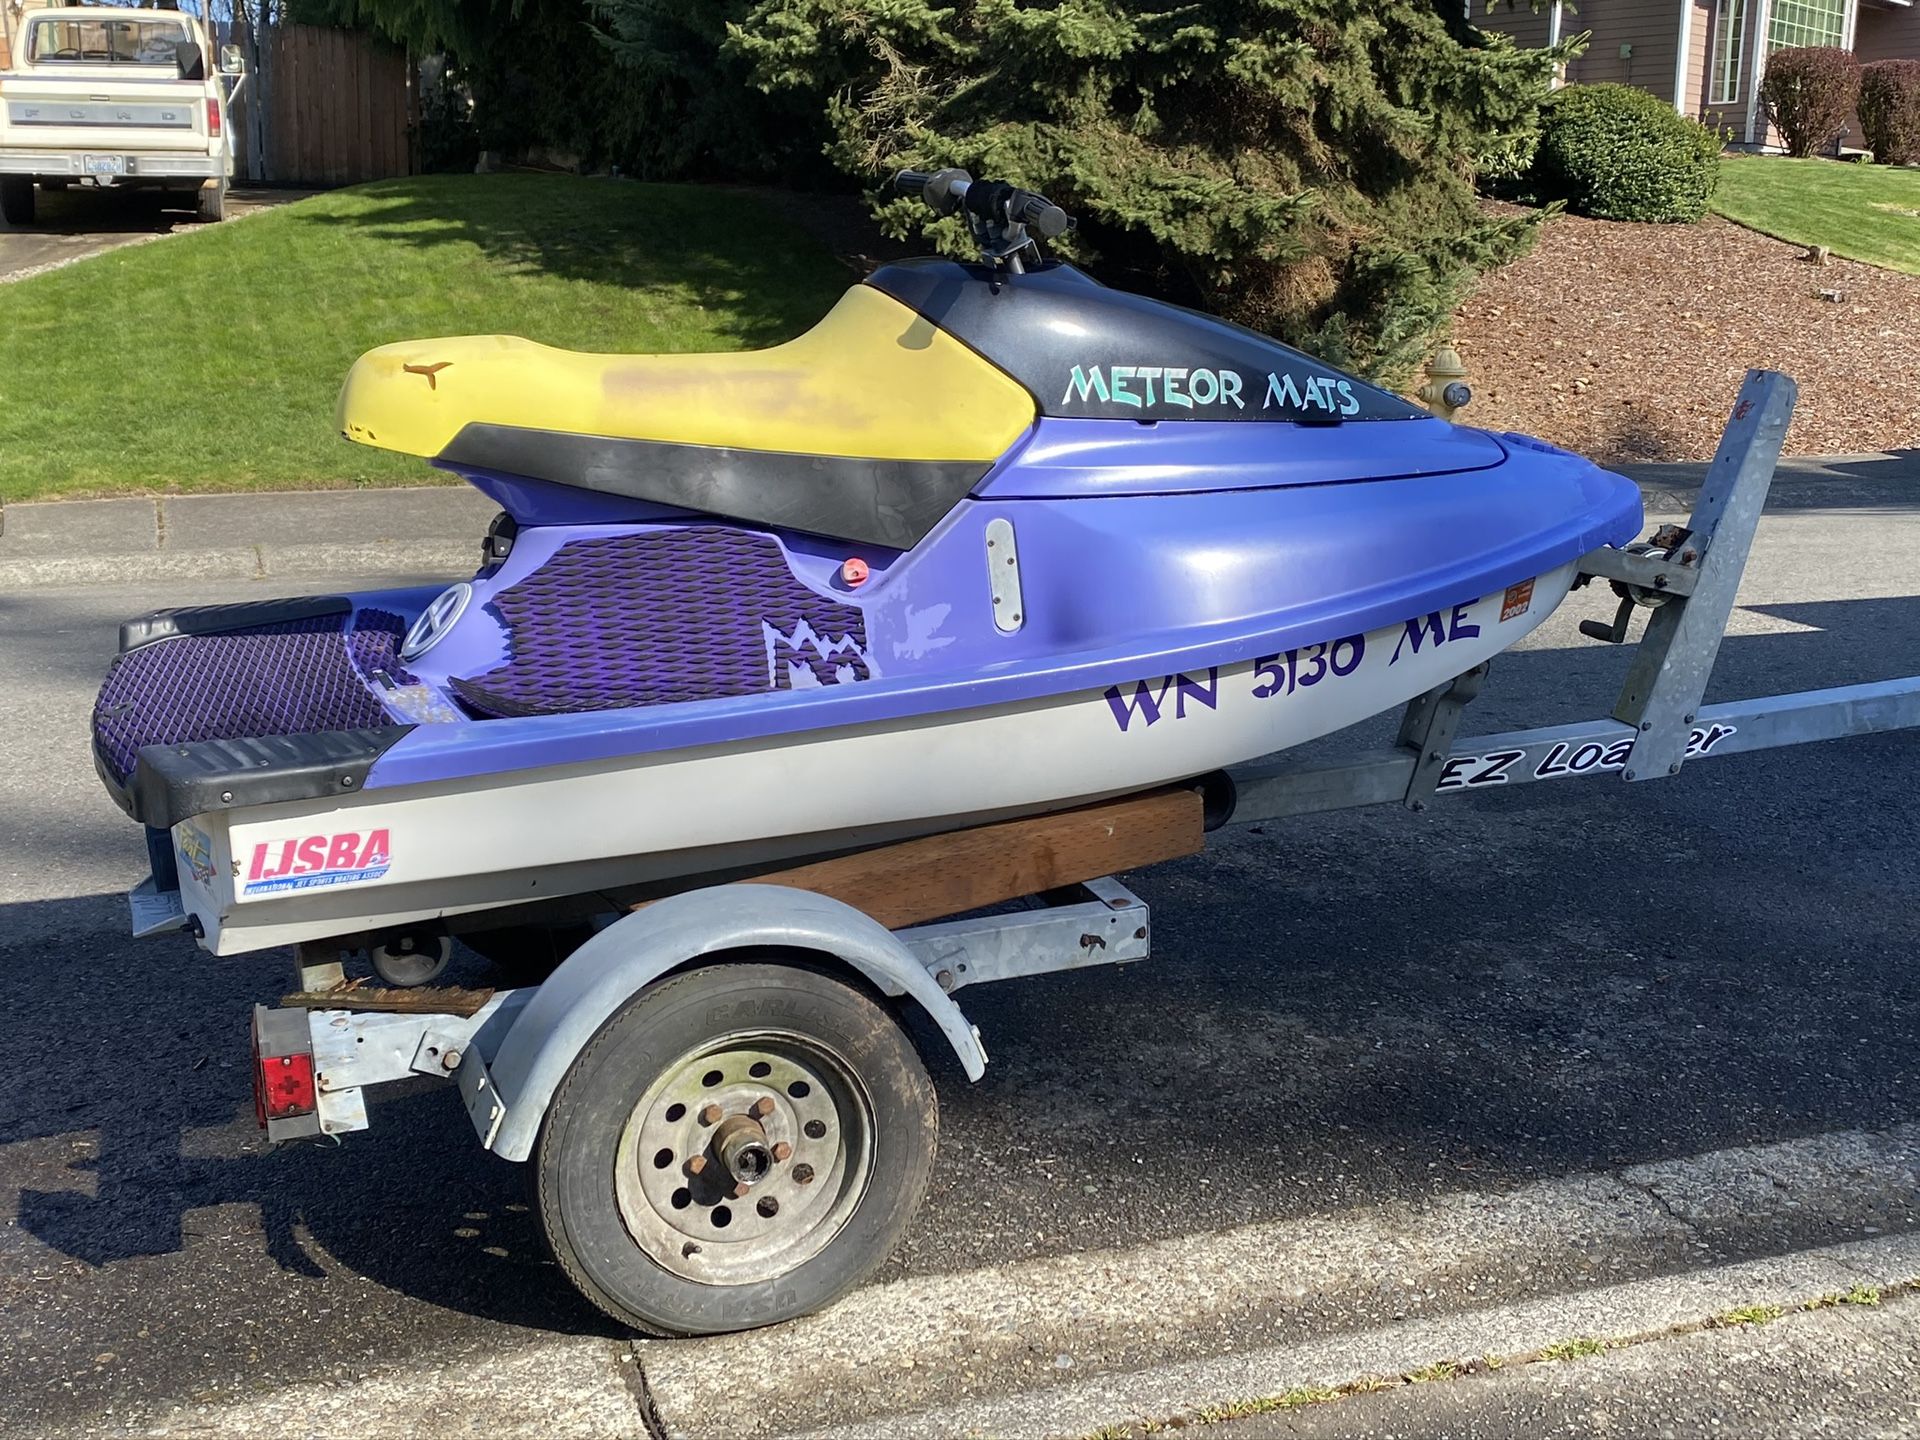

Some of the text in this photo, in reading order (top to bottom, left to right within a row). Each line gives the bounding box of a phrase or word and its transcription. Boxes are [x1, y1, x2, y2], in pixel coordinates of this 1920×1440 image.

[1061, 364, 1361, 415] METEOR MATS
[1103, 597, 1481, 732] WN 5130 ME
[1436, 724, 1737, 791] EZ Loaer
[247, 829, 390, 881] IJSBA
